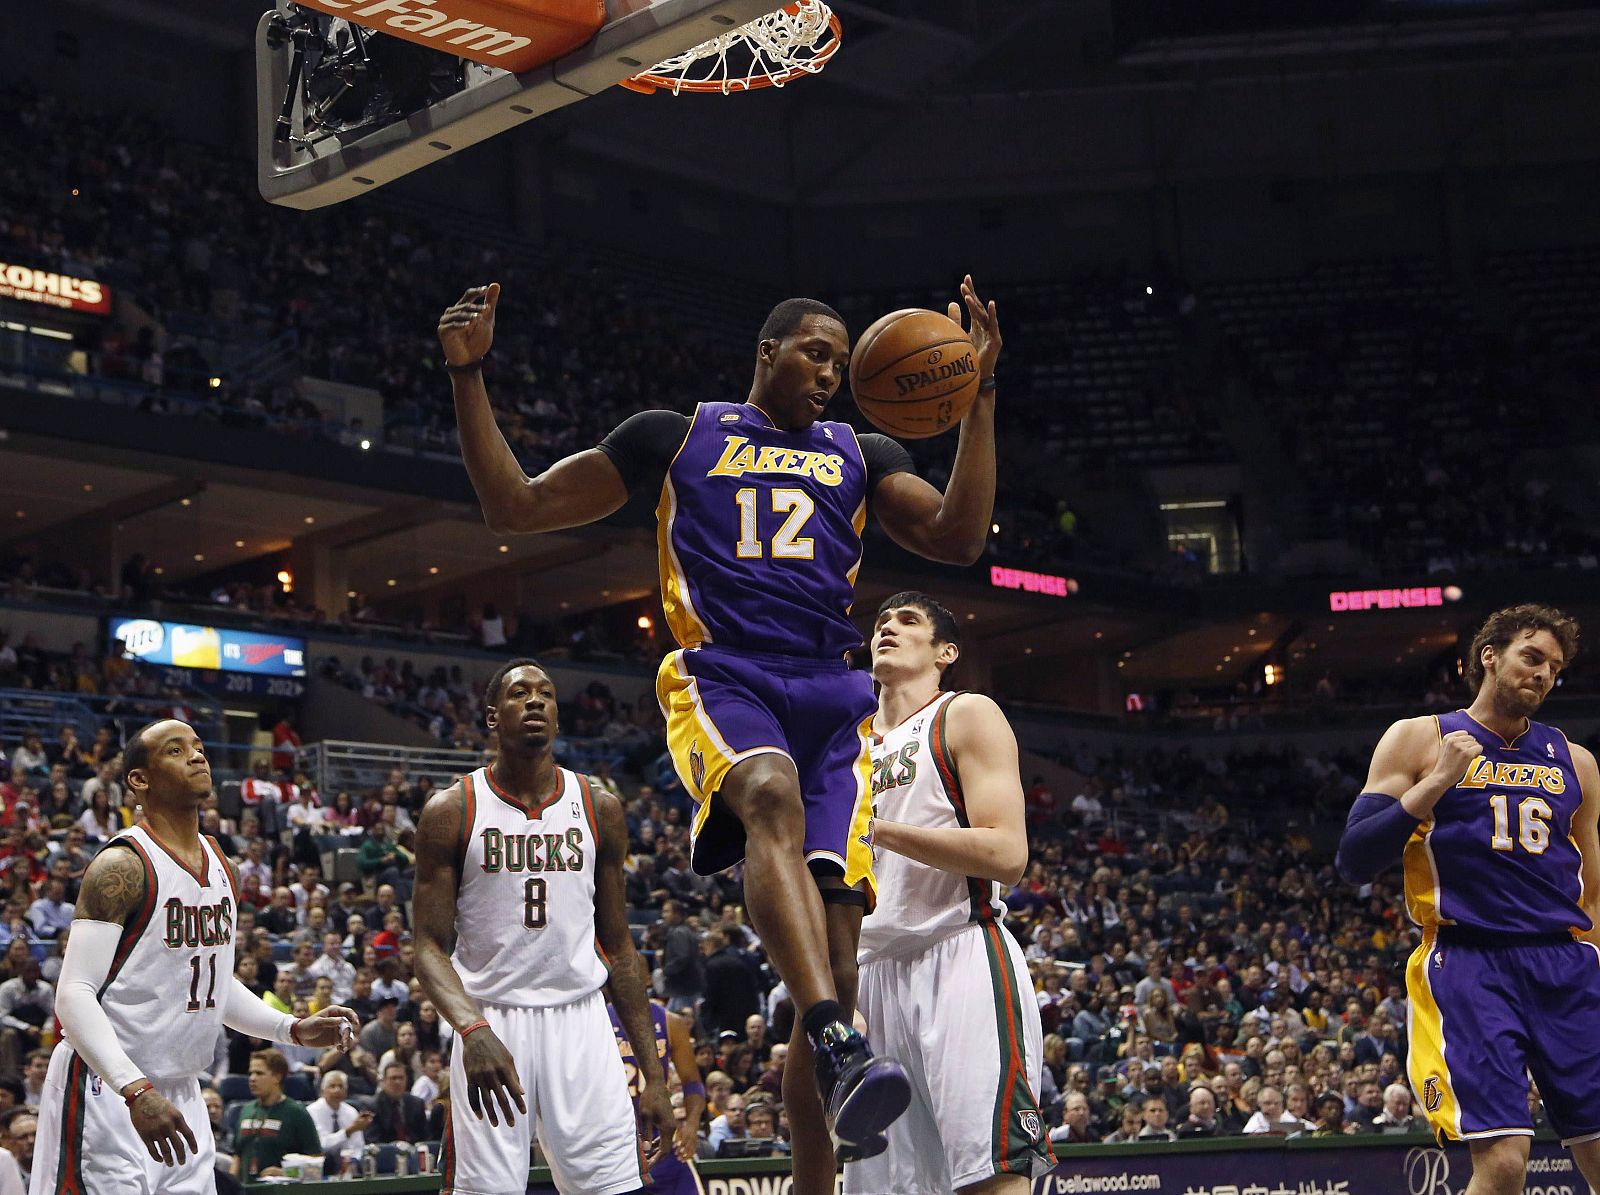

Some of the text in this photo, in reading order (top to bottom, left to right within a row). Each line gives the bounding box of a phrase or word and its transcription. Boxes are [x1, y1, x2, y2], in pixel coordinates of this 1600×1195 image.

[352, 0, 532, 57] Farm
[894, 352, 976, 396] SPALDING
[706, 435, 845, 487] LAKERS
[735, 488, 815, 560] 12
[990, 566, 1067, 597] DEFENSE
[1330, 586, 1443, 611] DEFENSE
[871, 741, 920, 796] CKS
[1456, 755, 1566, 795] LAKERS
[480, 827, 584, 873] BUCKS
[1489, 794, 1553, 855] 16
[162, 896, 233, 950] BUCKS
[523, 878, 548, 930] 8
[185, 953, 217, 1013] 11
[1055, 1172, 1161, 1194] bellawood.com
